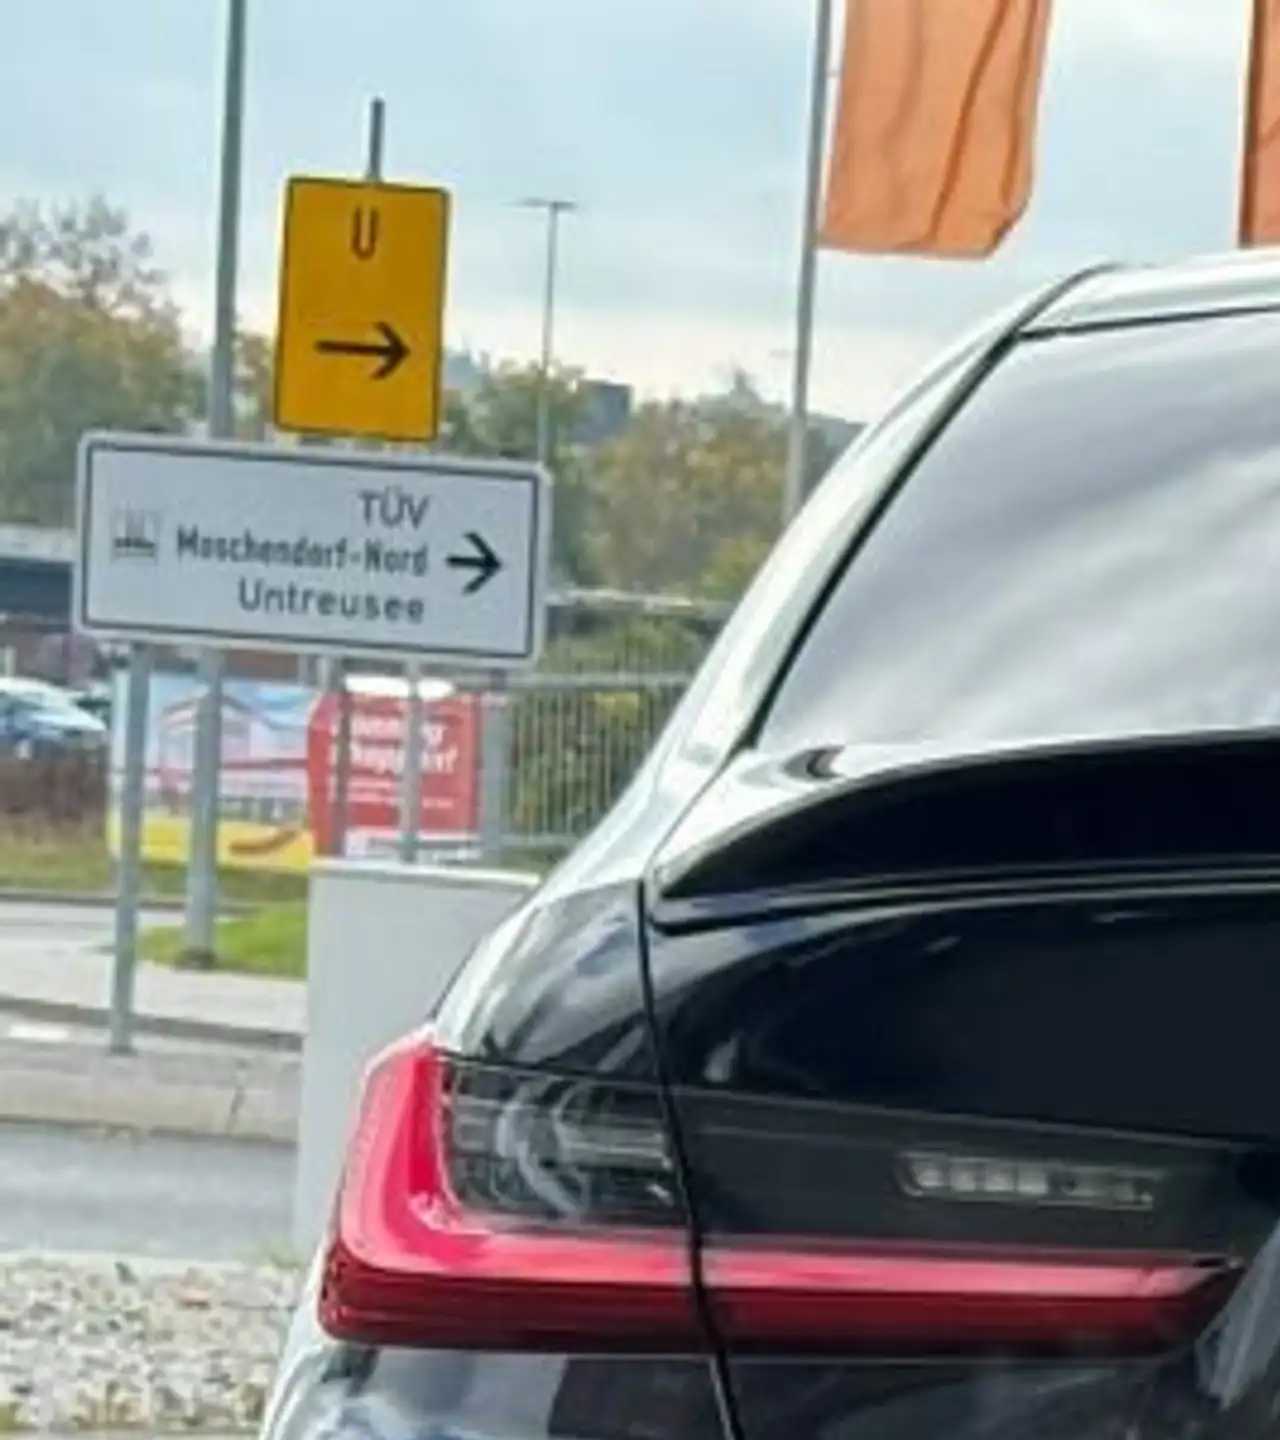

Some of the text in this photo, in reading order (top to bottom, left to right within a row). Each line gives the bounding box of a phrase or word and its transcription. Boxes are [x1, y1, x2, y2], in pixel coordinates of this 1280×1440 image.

[353, 205, 380, 260] U
[358, 486, 430, 529] TÜV
[176, 524, 428, 576] Moschendorf-Nord
[238, 578, 424, 622] Untreusee
